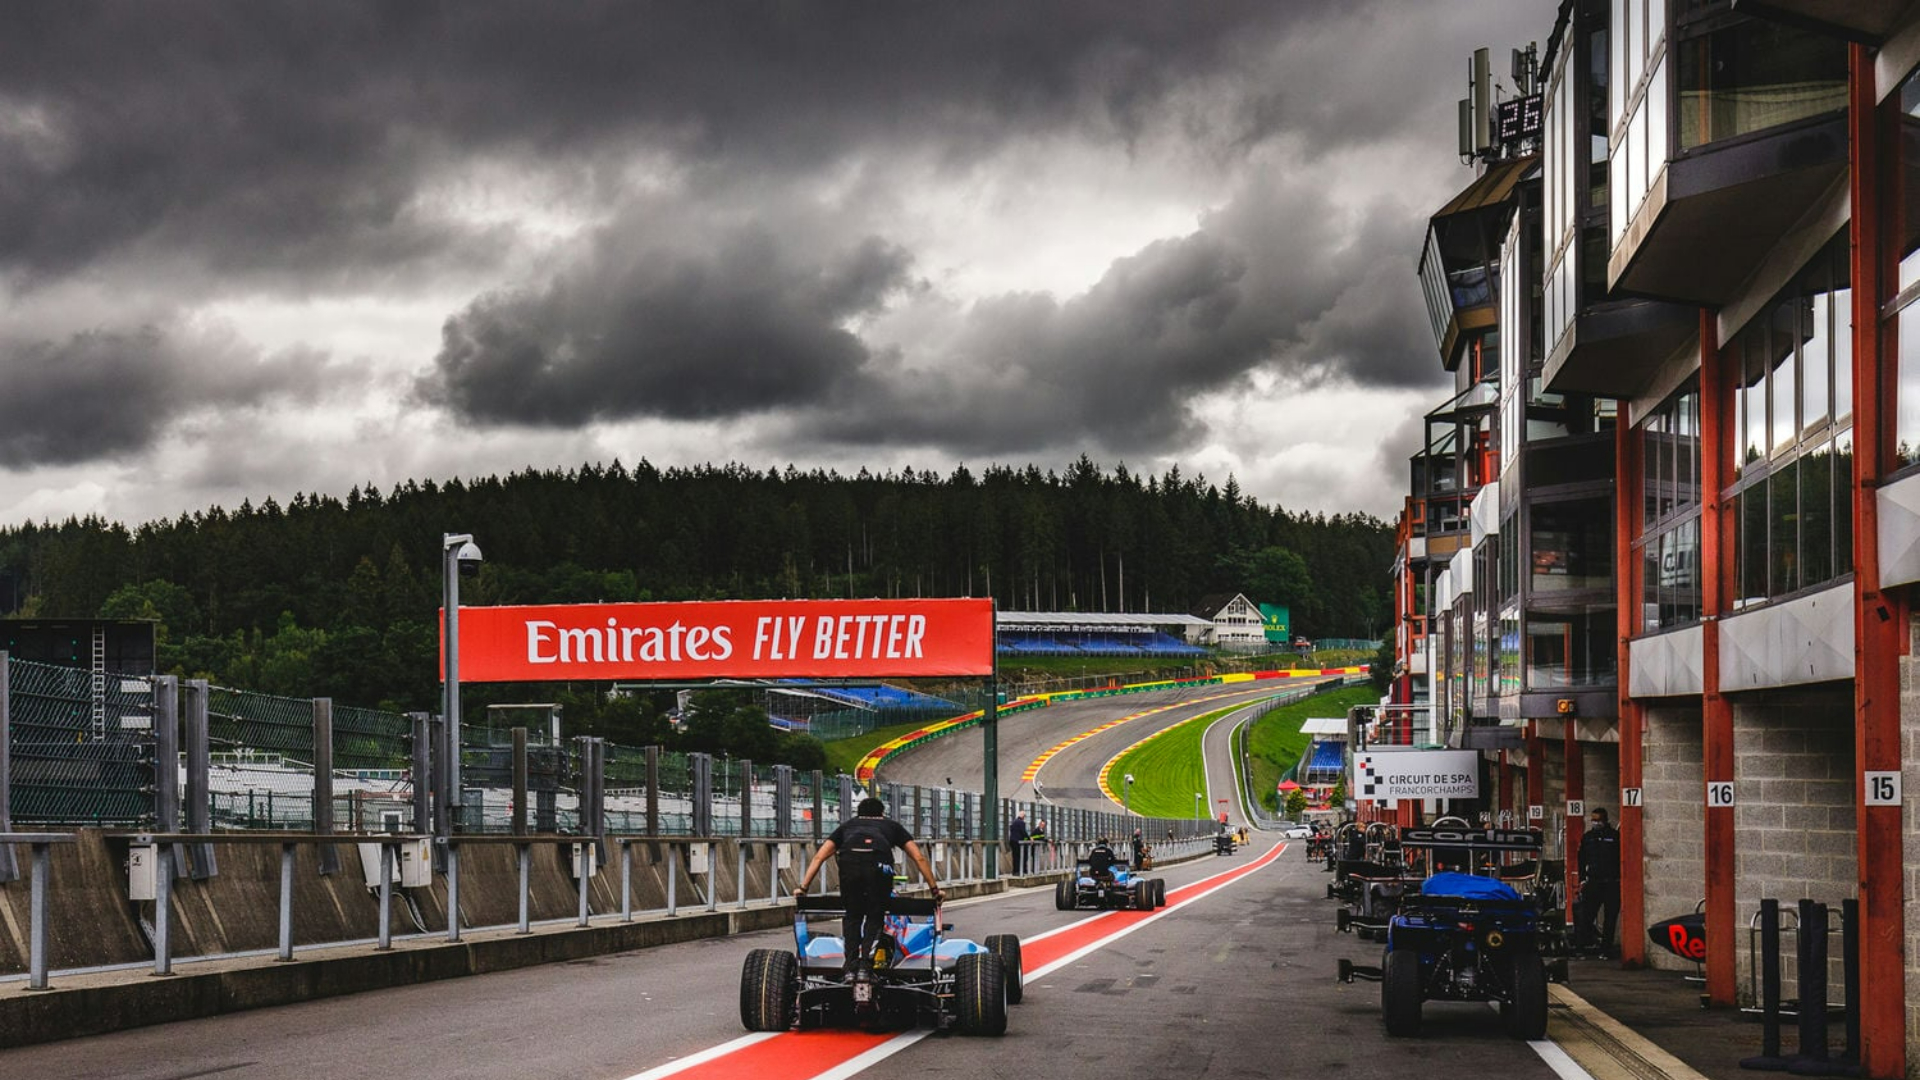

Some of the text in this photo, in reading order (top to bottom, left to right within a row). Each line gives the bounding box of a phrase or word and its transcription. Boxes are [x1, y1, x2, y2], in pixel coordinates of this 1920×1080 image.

[1502, 98, 1540, 137] 26
[526, 614, 926, 663] Emirates FLY BETTER
[1388, 773, 1473, 785] CIRCUIT DE SPA
[1389, 785, 1474, 795] FRANCORCHAMPS
[1625, 788, 1639, 805] 17
[1710, 784, 1733, 804] 16
[1871, 776, 1894, 800] 15
[1531, 807, 1541, 817] 19
[1570, 802, 1581, 814] 18
